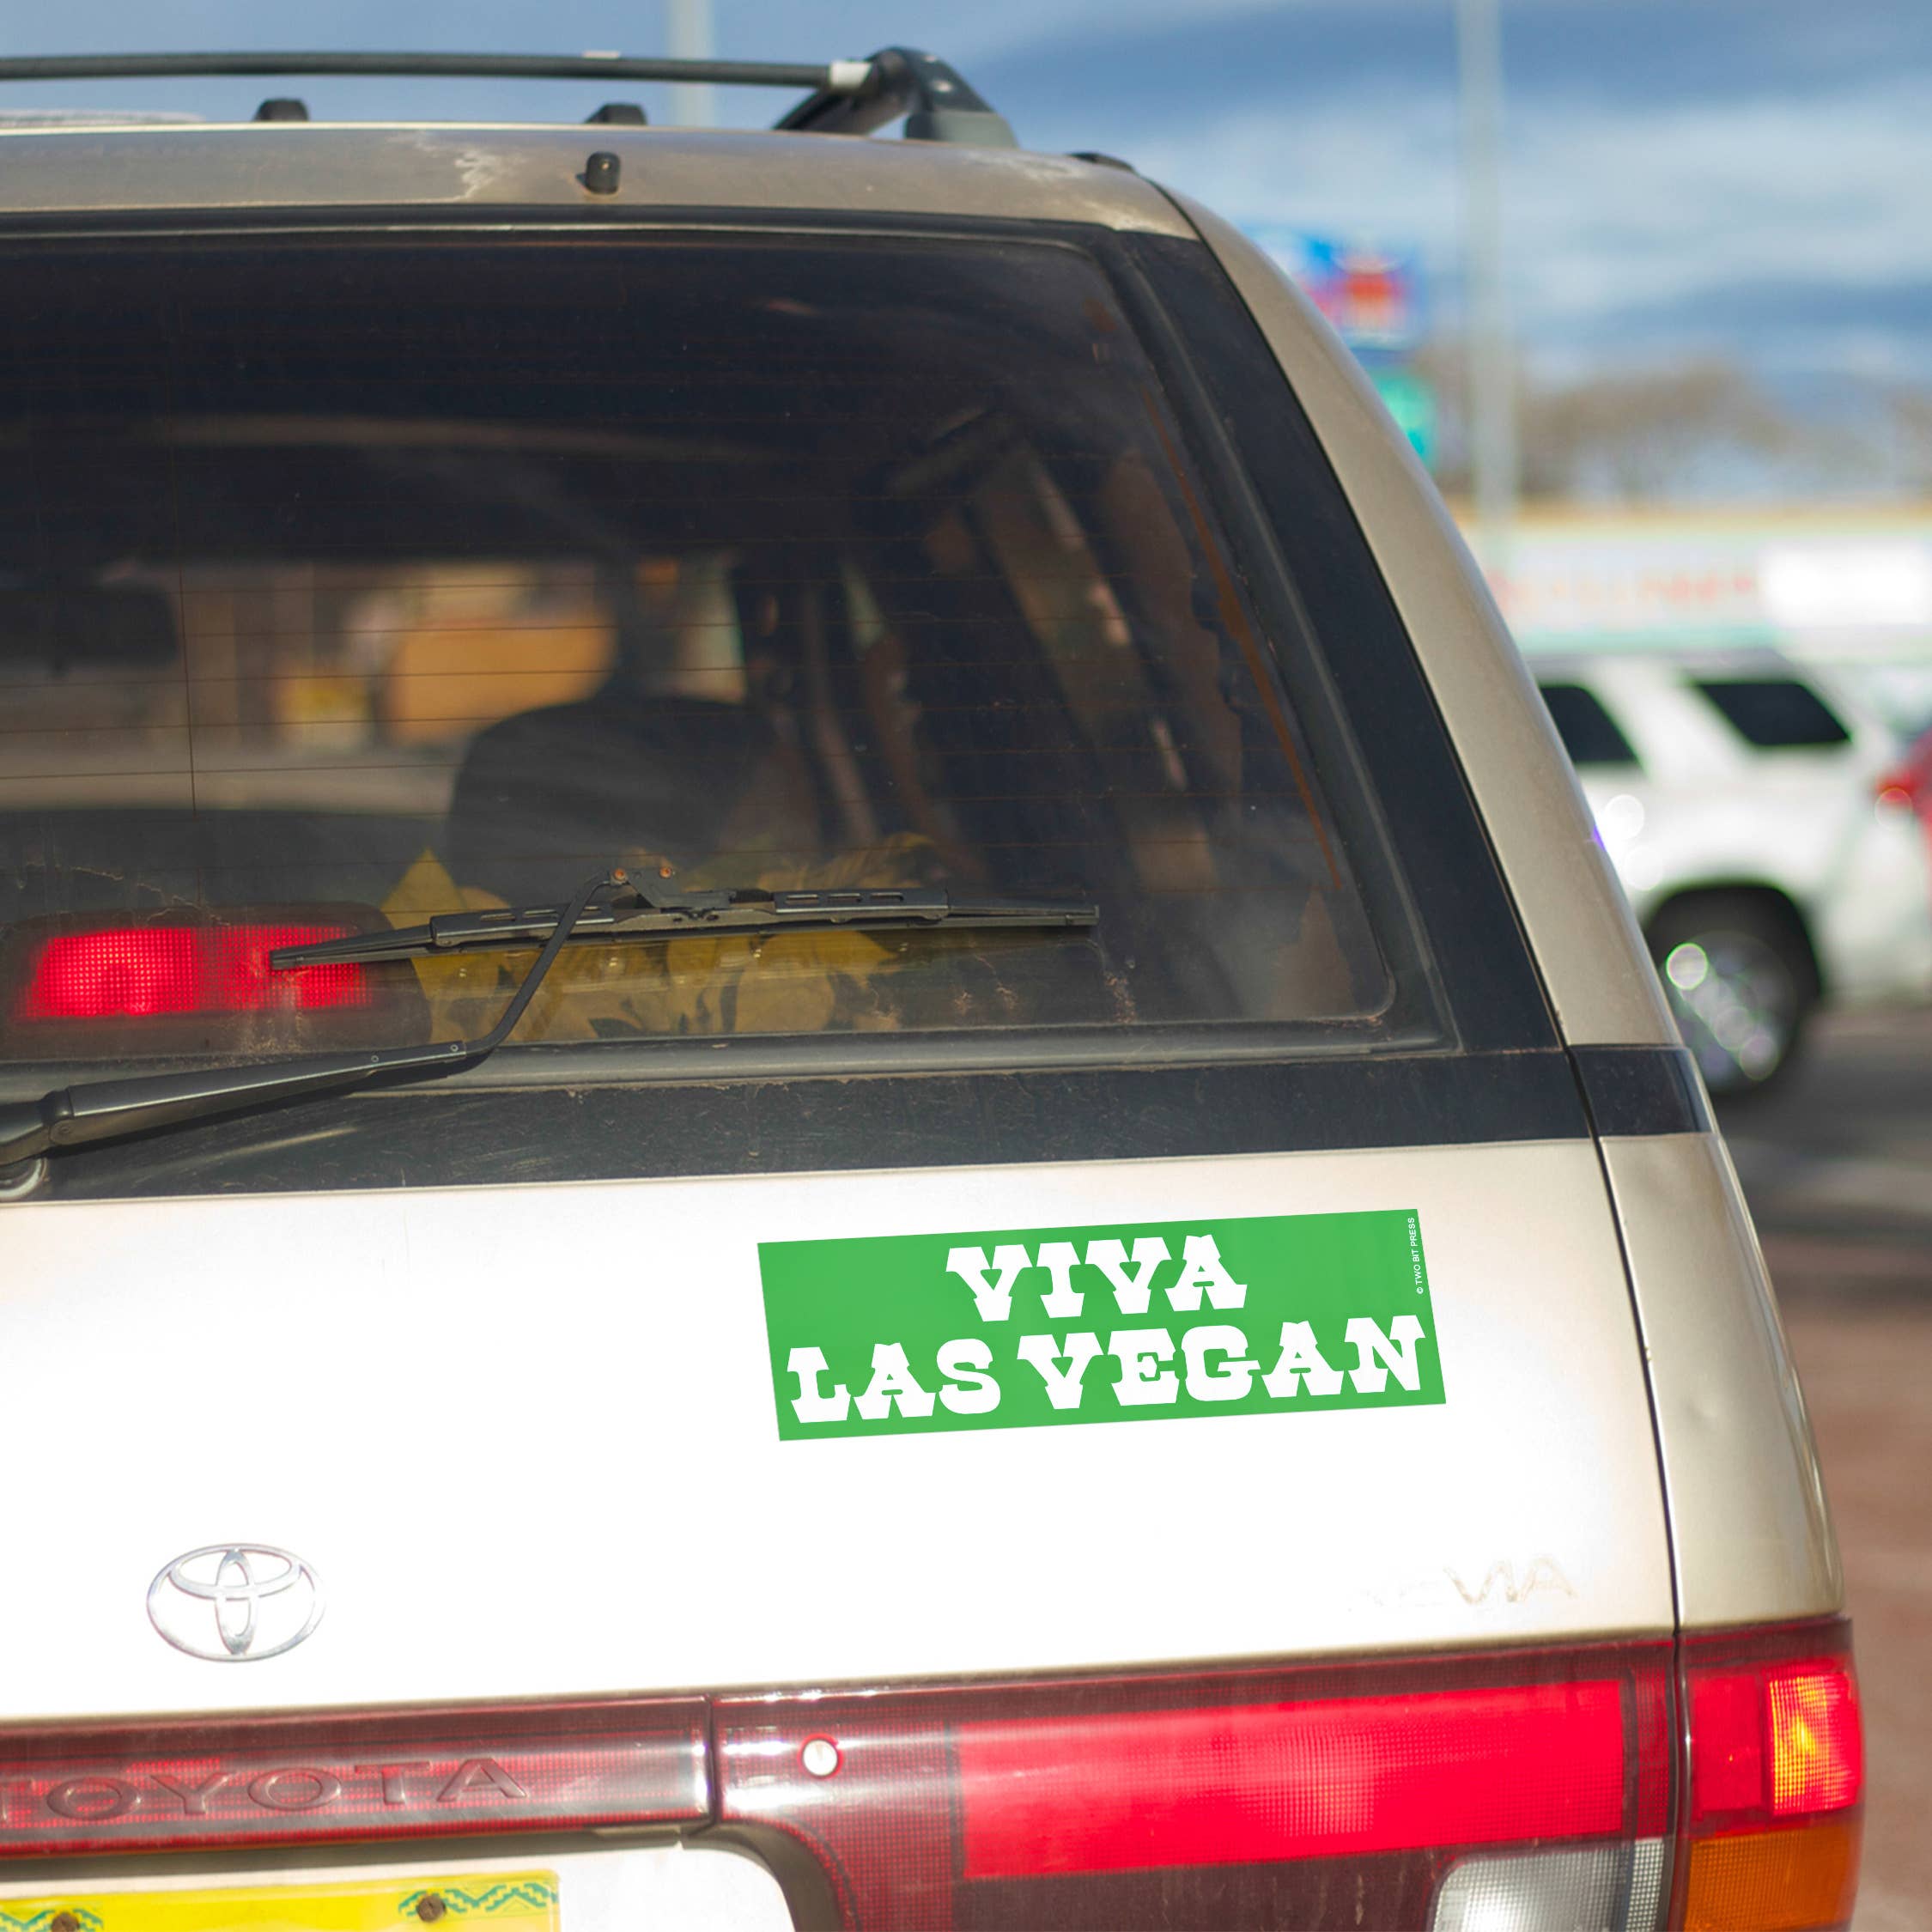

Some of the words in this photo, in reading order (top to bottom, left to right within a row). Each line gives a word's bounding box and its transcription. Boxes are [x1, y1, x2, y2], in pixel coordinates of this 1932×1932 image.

[1407, 1217, 1419, 1247] PRESS
[1411, 1249, 1420, 1262] BIT
[945, 1234, 1248, 1322] VIVA
[1413, 1264, 1423, 1285] TWO
[787, 1338, 1001, 1424] LAS
[1017, 1315, 1425, 1410] VEGAN
